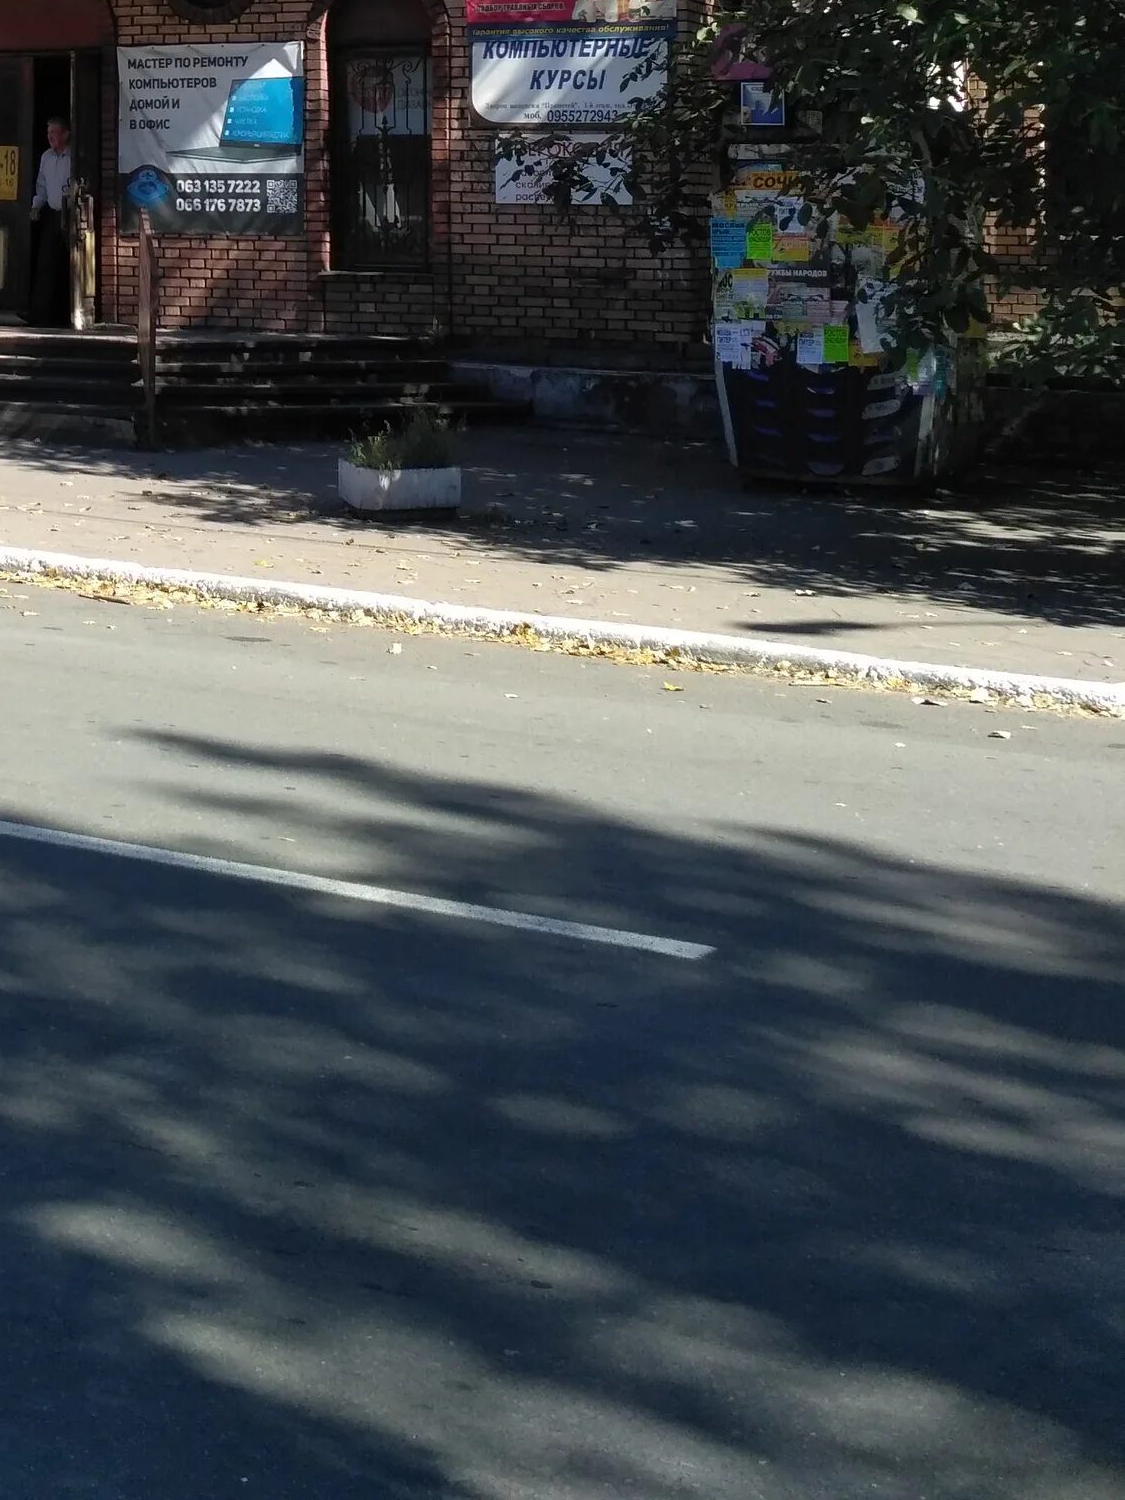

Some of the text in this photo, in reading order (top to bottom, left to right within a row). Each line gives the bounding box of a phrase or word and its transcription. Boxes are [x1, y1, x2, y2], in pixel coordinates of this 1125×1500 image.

[513, 28, 554, 37] высокого
[556, 26, 597, 35] качества
[483, 39, 651, 59] КОМПЬЮТЕРНЫЕ
[127, 56, 248, 69] МАСТЕР ПО РЕМОНТУ
[129, 77, 217, 90] КОМПЬЮТЕРОВ
[530, 69, 606, 90] КУРСЫ
[129, 96, 180, 111] ДОМОЙ И
[524, 109, 619, 122] моб. 0955272943
[129, 119, 170, 130] В ОФИС
[176, 179, 261, 193] 063 135 7222
[176, 198, 261, 212] 066 176 7873
[793, 269, 828, 278] НАРОДОВ
